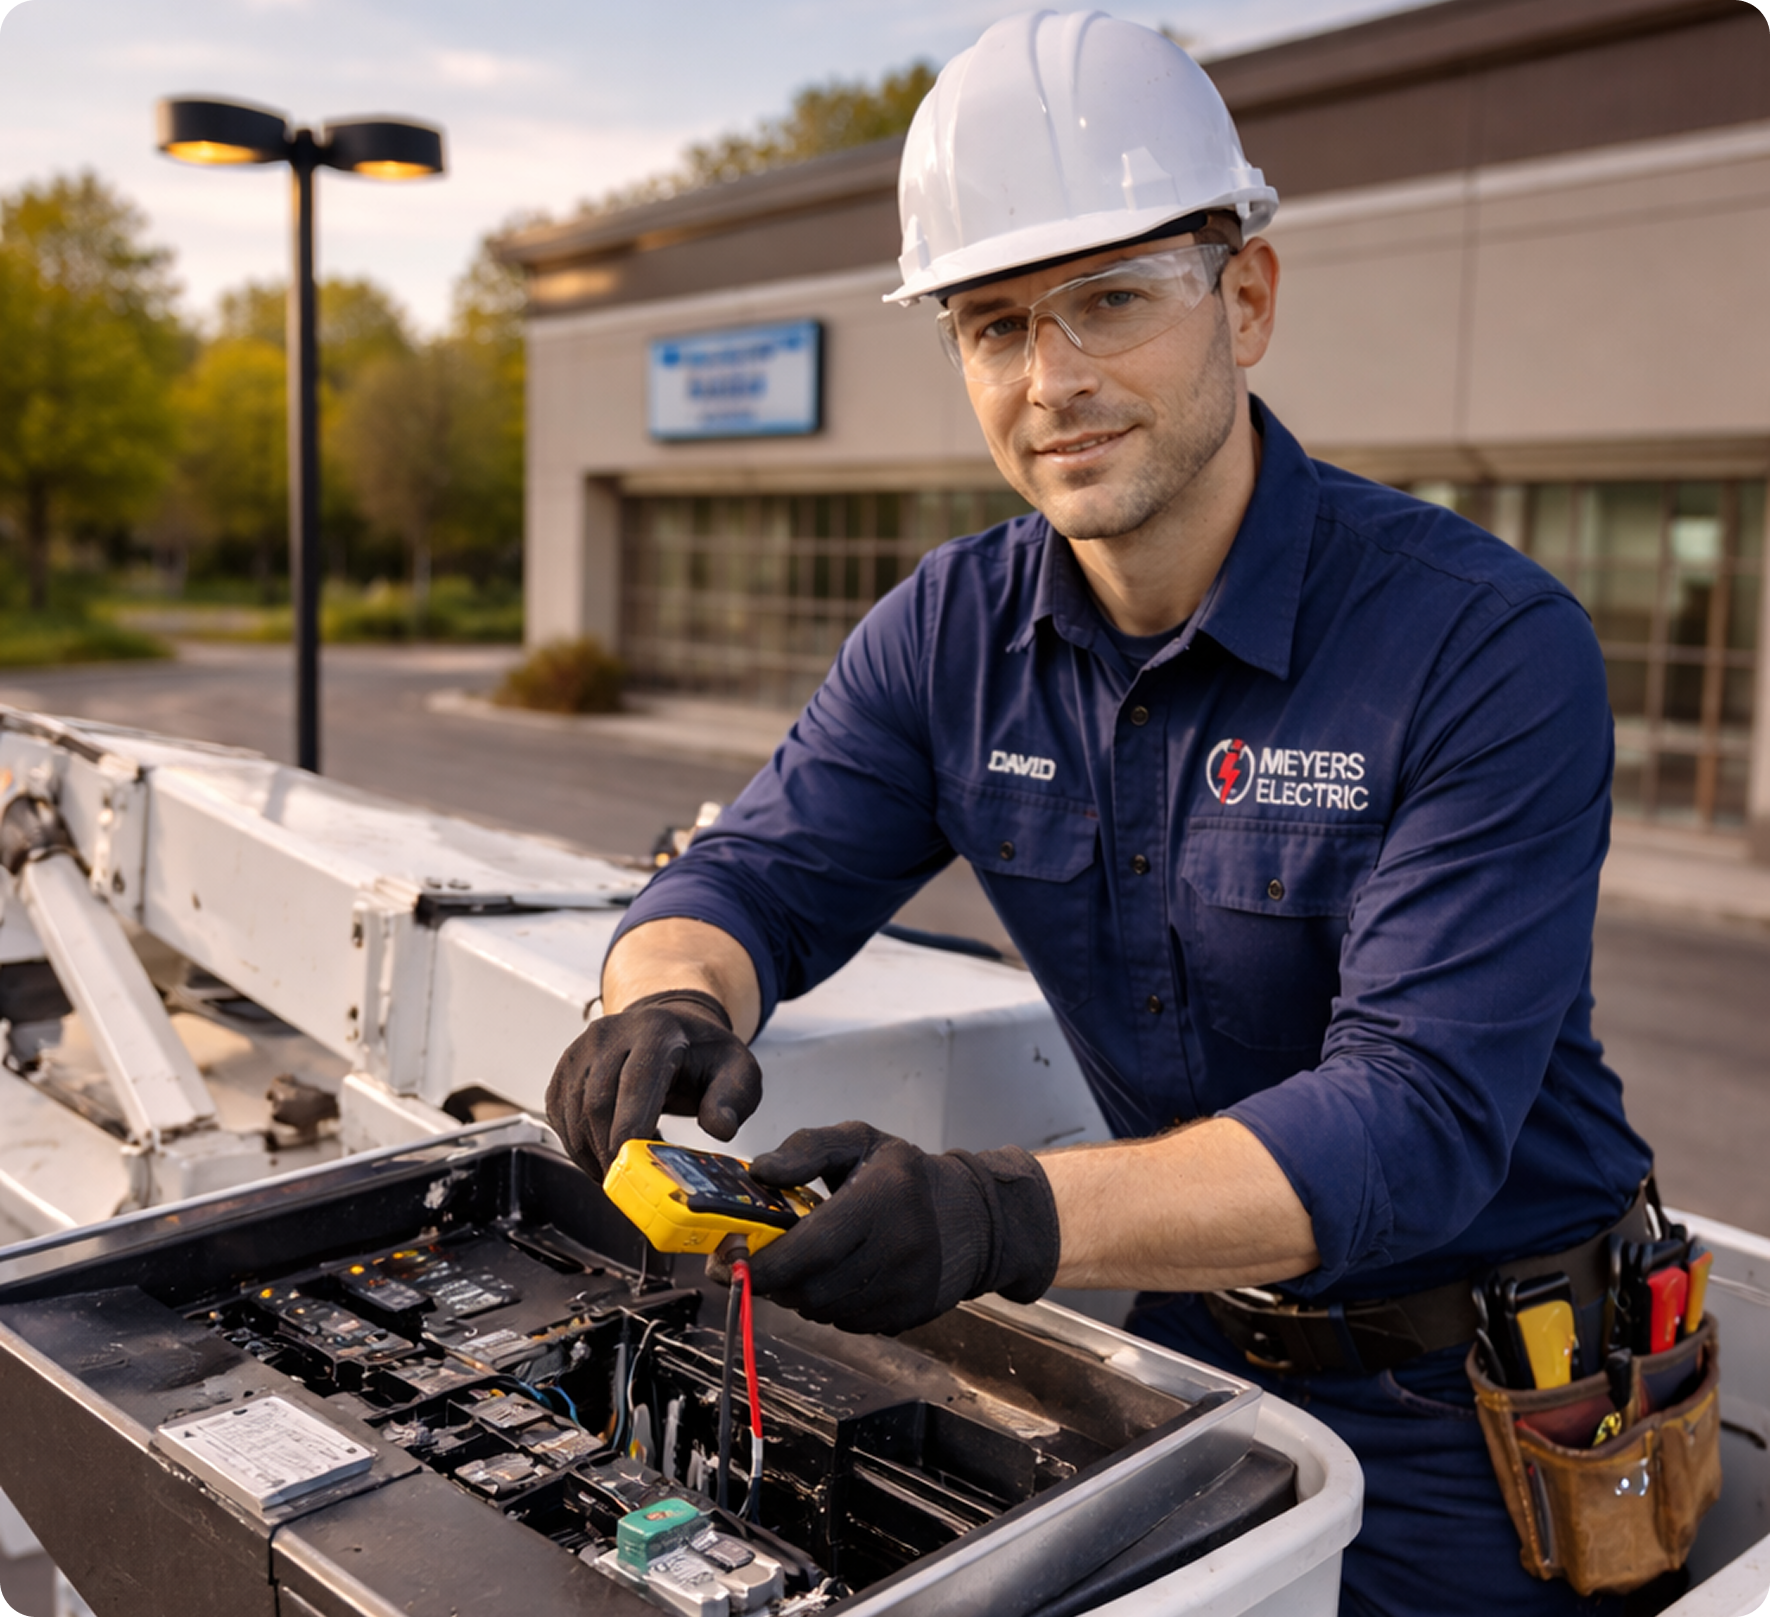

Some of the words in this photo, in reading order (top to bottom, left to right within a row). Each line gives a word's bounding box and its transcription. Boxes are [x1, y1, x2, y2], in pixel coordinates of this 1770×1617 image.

[987, 749, 1056, 781] DAVID
[1259, 747, 1366, 780] MEYERS
[1256, 778, 1369, 811] ELECTRIC
